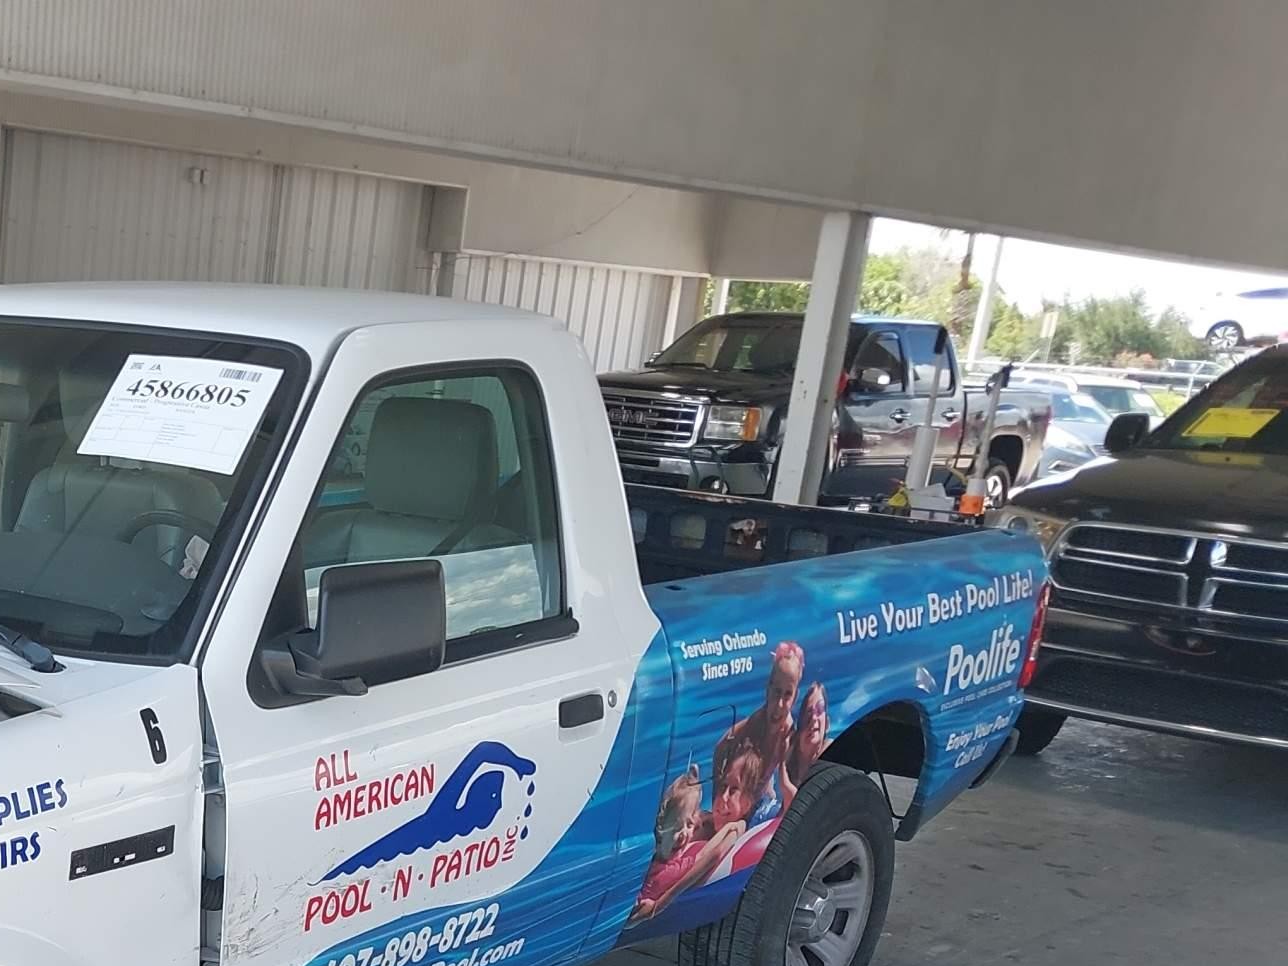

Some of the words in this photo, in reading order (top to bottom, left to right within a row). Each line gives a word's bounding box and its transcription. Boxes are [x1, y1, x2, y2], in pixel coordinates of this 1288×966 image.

[127, 378, 251, 407] 45866805
[837, 610, 878, 644] Live
[880, 602, 924, 634] Your
[927, 590, 962, 624] Best
[965, 577, 1000, 613] Pool
[1002, 569, 1033, 604] Life!
[680, 638, 723, 660] Serving
[722, 628, 767, 651] Orlando
[702, 662, 729, 681] Since
[730, 656, 753, 675] 1976
[943, 623, 1021, 696] Poolife
[139, 707, 167, 765] 6
[314, 750, 358, 792] ALL
[314, 764, 435, 830] AMERICAN
[304, 883, 372, 932] POOL
[393, 866, 413, 901] N
[430, 836, 500, 889] PATIO
